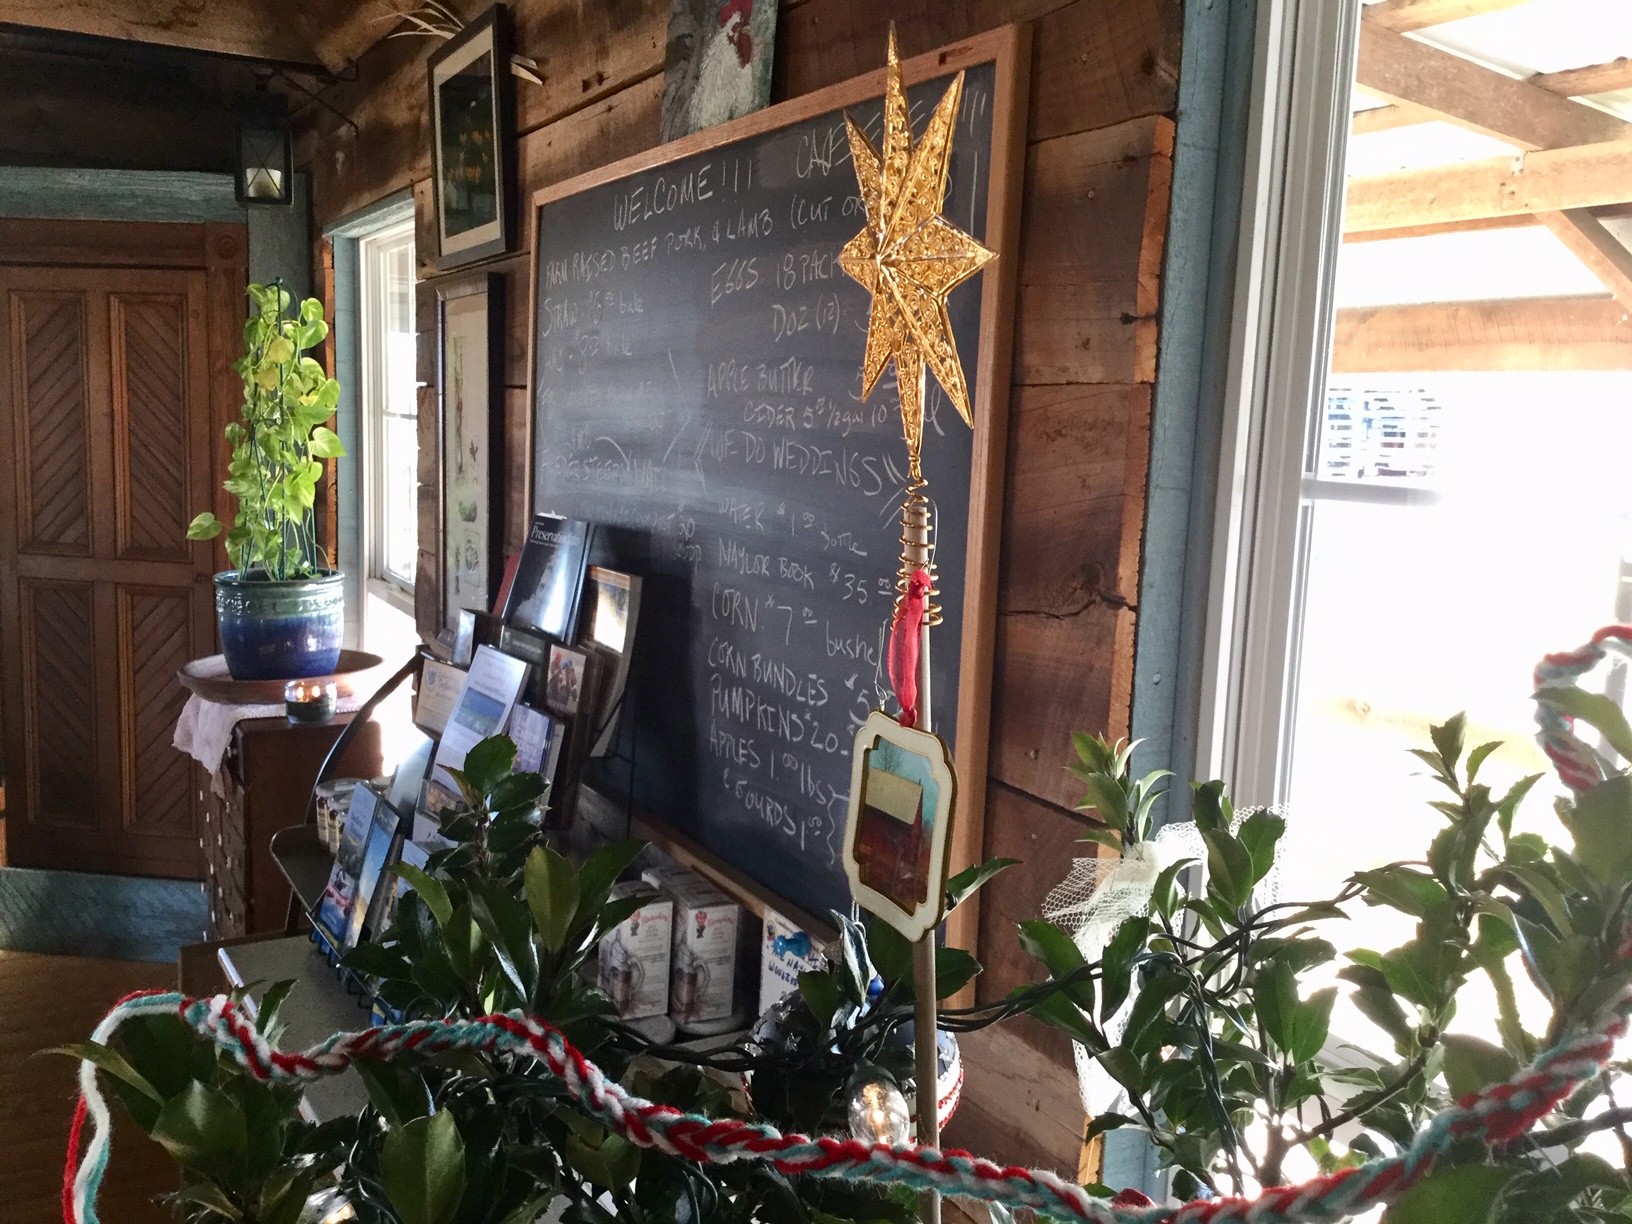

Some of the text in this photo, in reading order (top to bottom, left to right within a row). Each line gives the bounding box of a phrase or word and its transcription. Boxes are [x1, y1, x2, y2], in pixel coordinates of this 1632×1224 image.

[613, 164, 713, 231] WELCOME
[620, 237, 657, 271] BEEF
[727, 208, 773, 240] LAMB
[711, 257, 759, 308] EGGS
[776, 253, 796, 290] 18
[706, 358, 749, 398] APPLE
[741, 430, 766, 464] DO
[718, 538, 770, 576] NAYLOR
[778, 557, 815, 590] BOOK
[707, 637, 747, 678] CORN
[751, 653, 829, 707] BUNDLES
[709, 672, 805, 742] PUMPKINS
[709, 718, 761, 768] APPLES
